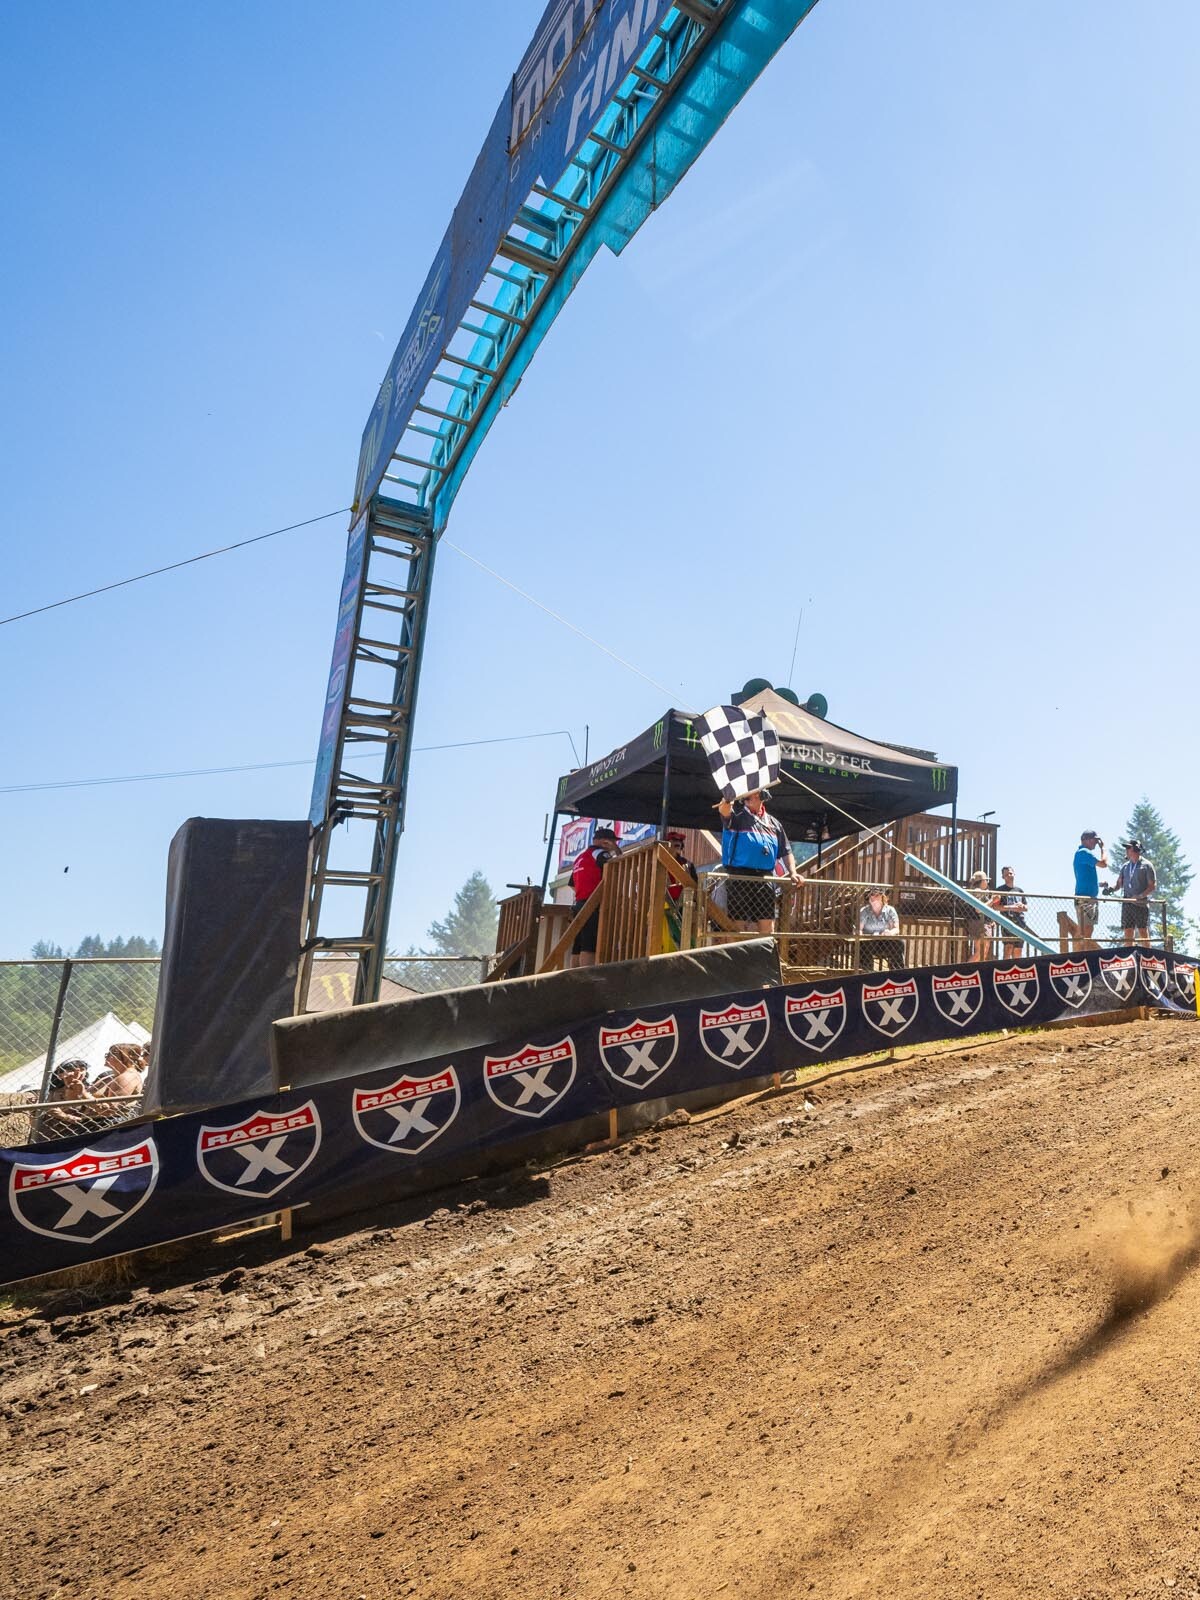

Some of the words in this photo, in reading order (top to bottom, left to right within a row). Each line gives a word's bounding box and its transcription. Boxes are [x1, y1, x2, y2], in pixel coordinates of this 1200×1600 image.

[780, 742, 873, 773] MONSTER
[793, 762, 860, 780] ENERGY
[935, 978, 977, 990] RACER
[996, 971, 1034, 982] RACER
[1052, 966, 1086, 975] RACER
[1111, 970, 1131, 992] X
[1147, 970, 1161, 990] X
[1183, 974, 1196, 994] X
[865, 985, 914, 999] RACER
[1006, 982, 1032, 1007] X
[1061, 975, 1085, 999] X
[789, 995, 842, 1012] RACER
[876, 997, 907, 1027] X
[946, 989, 974, 1016] X
[704, 1009, 764, 1027] RACER
[803, 1010, 834, 1041] X
[605, 1025, 672, 1045] RACER
[718, 1023, 754, 1058] X
[490, 1047, 569, 1076] RACER
[621, 1040, 660, 1078] X
[360, 1077, 450, 1109] RACER
[511, 1064, 558, 1108] X
[206, 1113, 309, 1147] RACER
[382, 1097, 440, 1144] X
[21, 1152, 145, 1187] RACER
[233, 1135, 295, 1187] X
[52, 1176, 124, 1230] X
